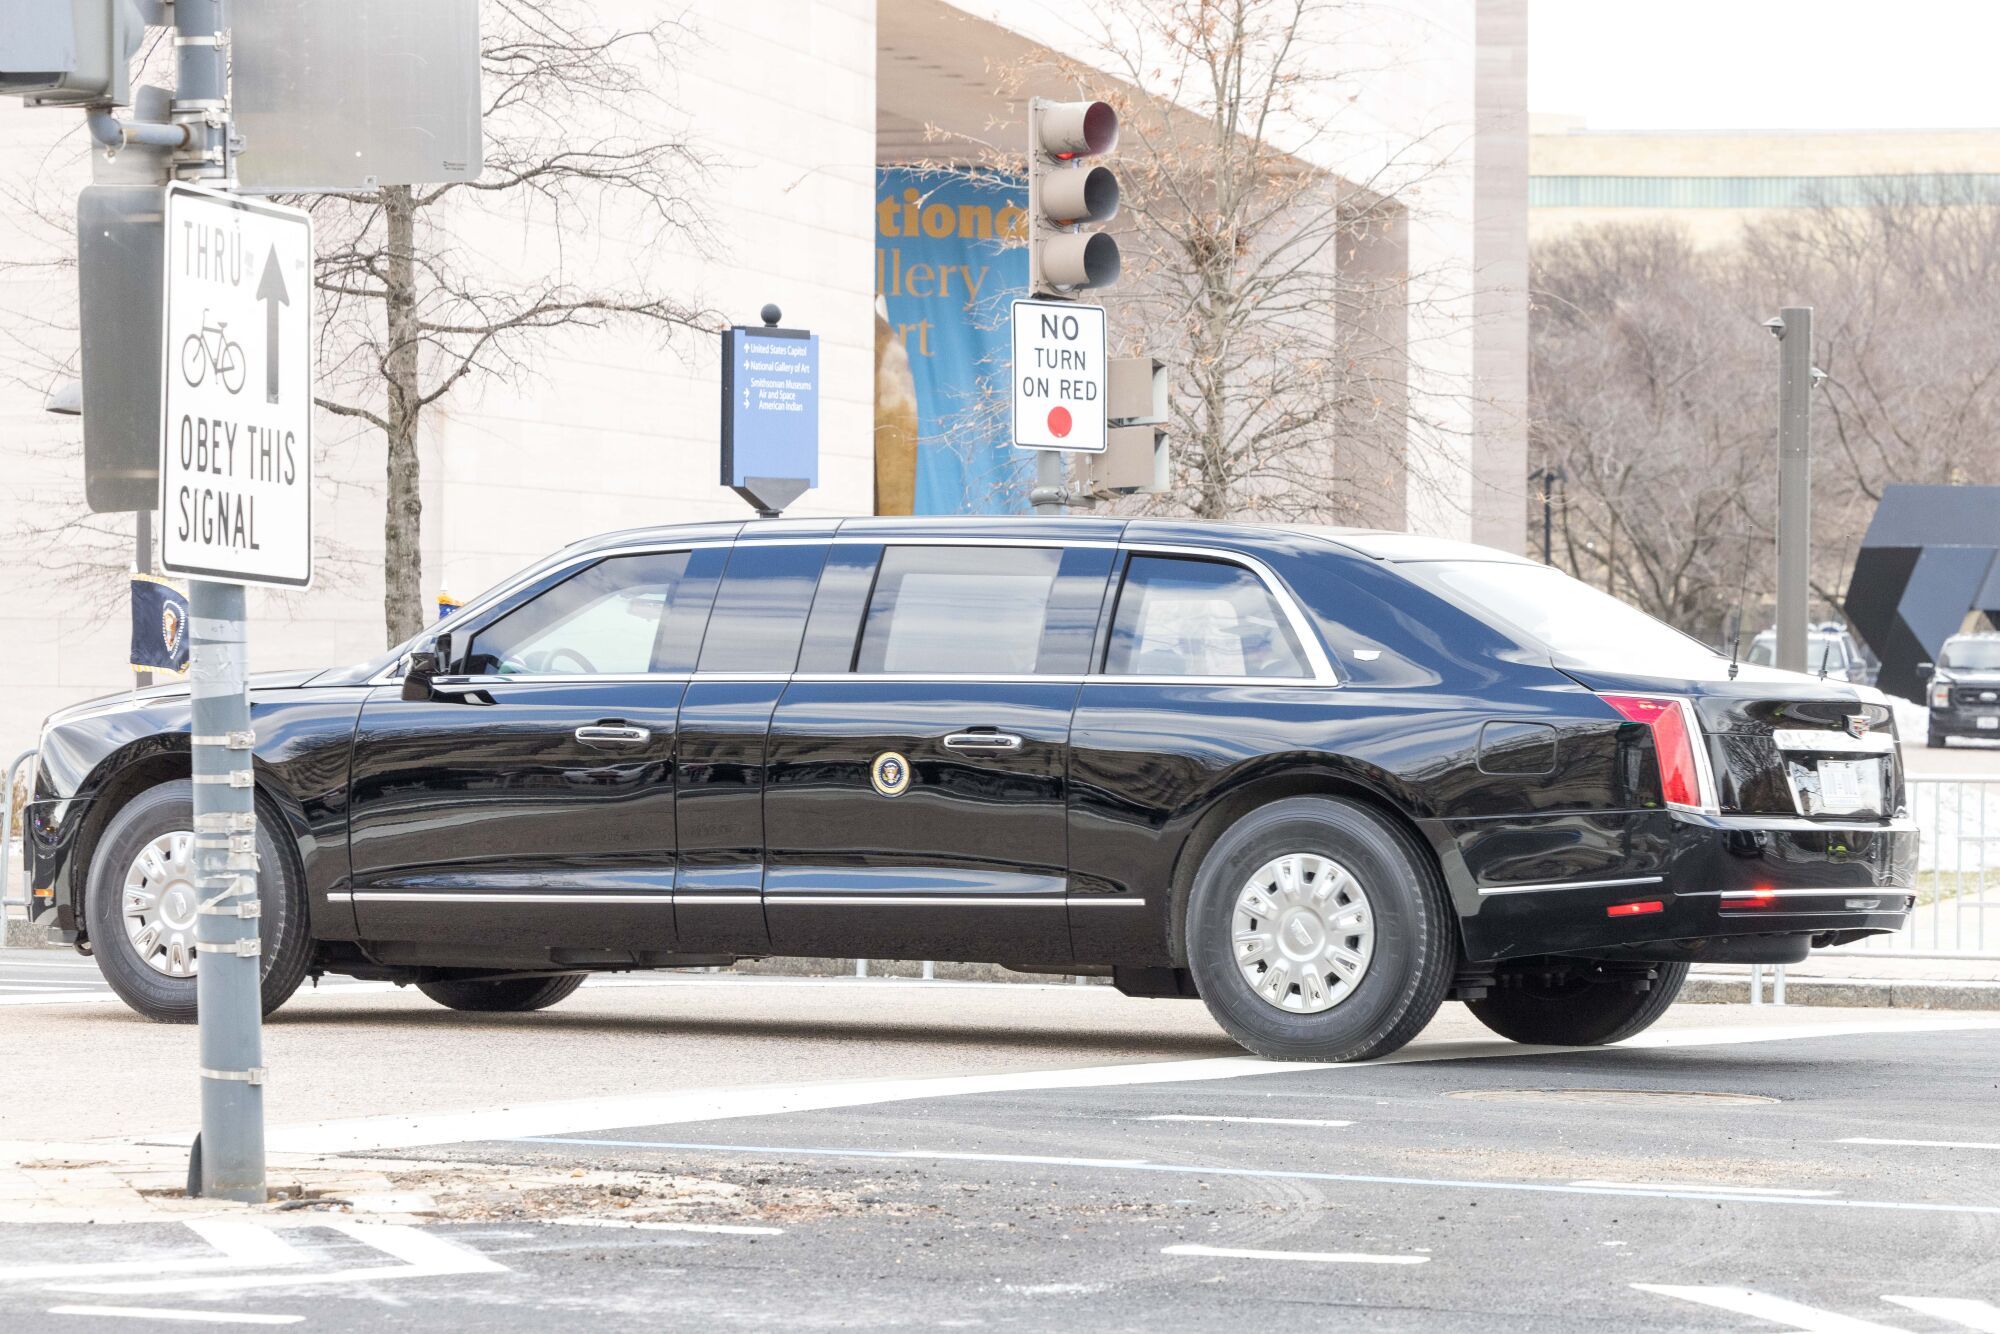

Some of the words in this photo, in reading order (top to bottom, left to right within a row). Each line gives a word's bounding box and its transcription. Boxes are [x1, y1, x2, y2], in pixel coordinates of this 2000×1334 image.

[184, 220, 241, 287] THRU
[1041, 313, 1079, 341] NO
[751, 343, 769, 354] United
[770, 344, 787, 355] States
[788, 346, 807, 357] Capitol
[1034, 347, 1086, 371] TURN
[751, 361, 773, 371] National
[775, 362, 793, 374] Gallery
[795, 363, 801, 373] of
[801, 363, 810, 373] Art
[751, 378, 784, 388] Smithsonian
[786, 380, 811, 390] Museums
[759, 388, 767, 398] Air
[768, 389, 779, 399] and
[780, 390, 795, 401] Space
[1023, 376, 1049, 398] ON
[1060, 379, 1097, 401] RED
[759, 400, 784, 410] American
[786, 402, 802, 411] Indian
[180, 414, 238, 477] OBEY
[247, 425, 296, 486] THIS
[178, 485, 260, 551] SIGNAL
